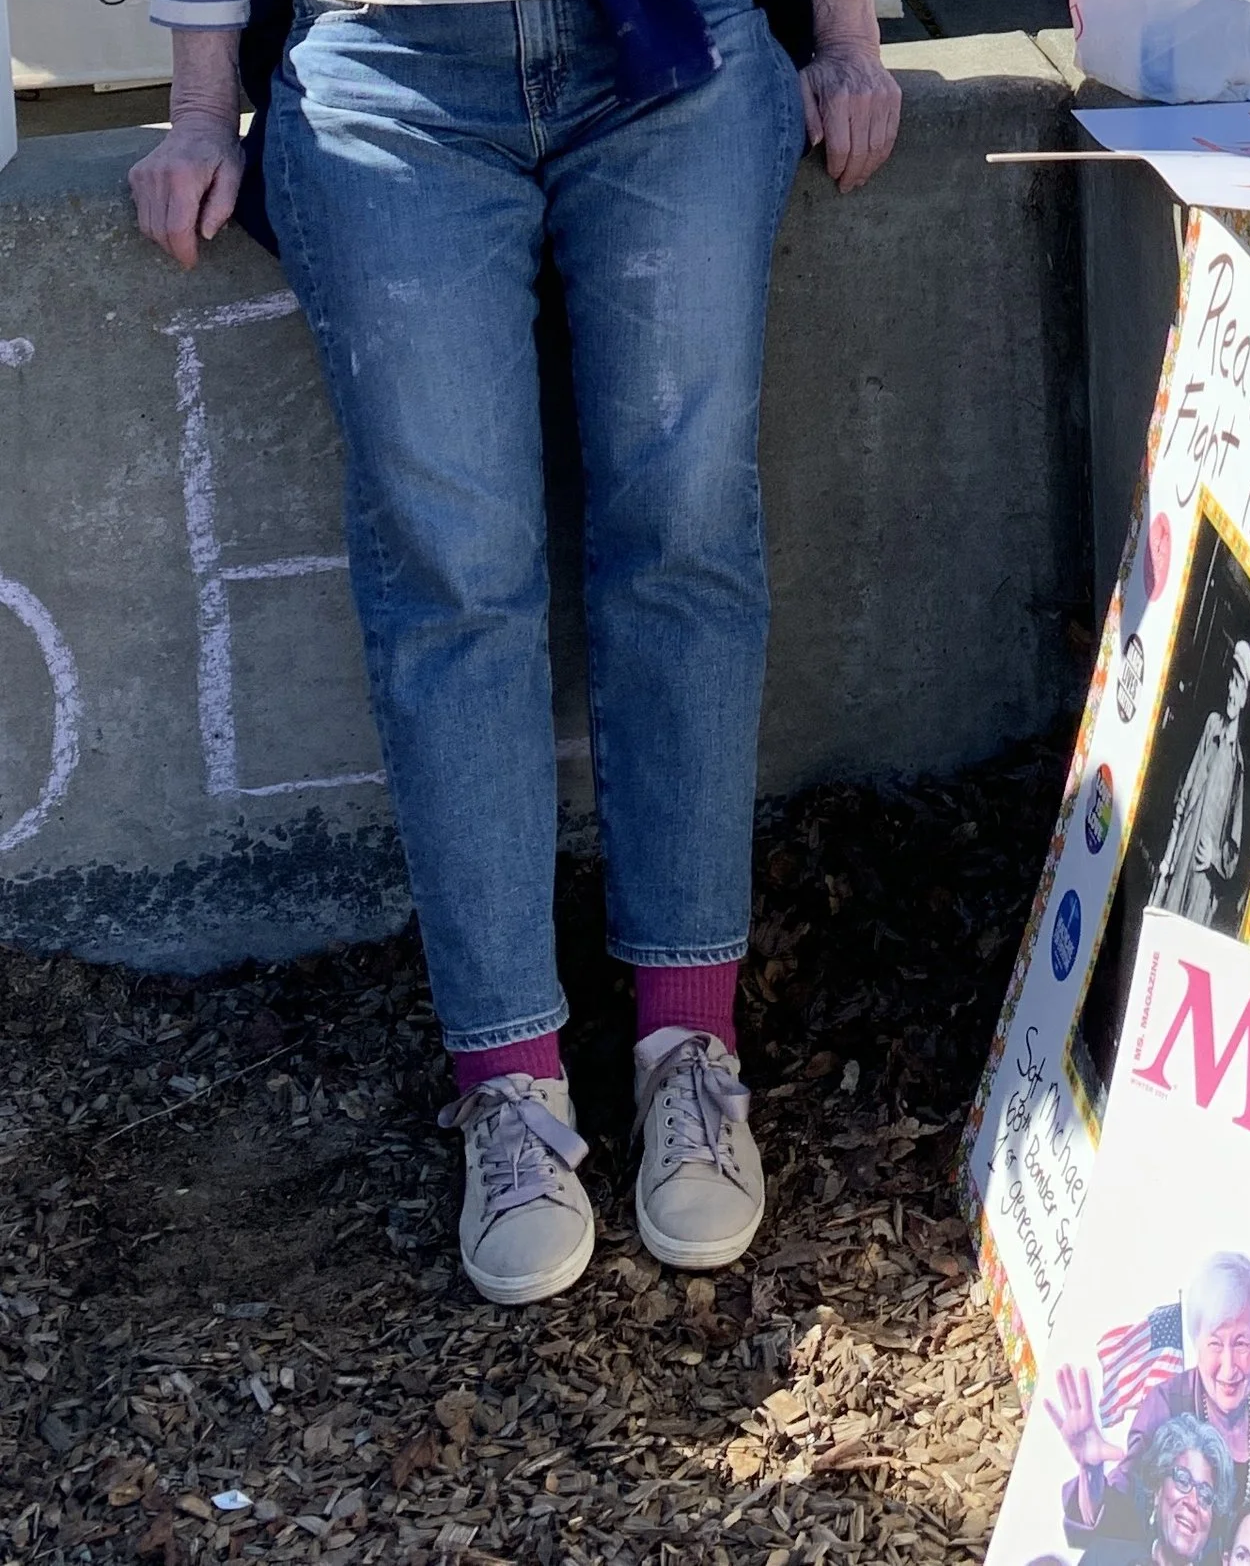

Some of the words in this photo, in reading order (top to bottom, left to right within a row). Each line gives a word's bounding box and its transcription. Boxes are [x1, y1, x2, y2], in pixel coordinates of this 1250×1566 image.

[1163, 373, 1240, 508] Fight
[1122, 662, 1138, 701] LIVES
[1133, 1034, 1145, 1061] MS.
[1140, 950, 1160, 1029] MAGAZINE
[1016, 1026, 1046, 1103] Sgt
[1001, 1180, 1051, 1303] generation
